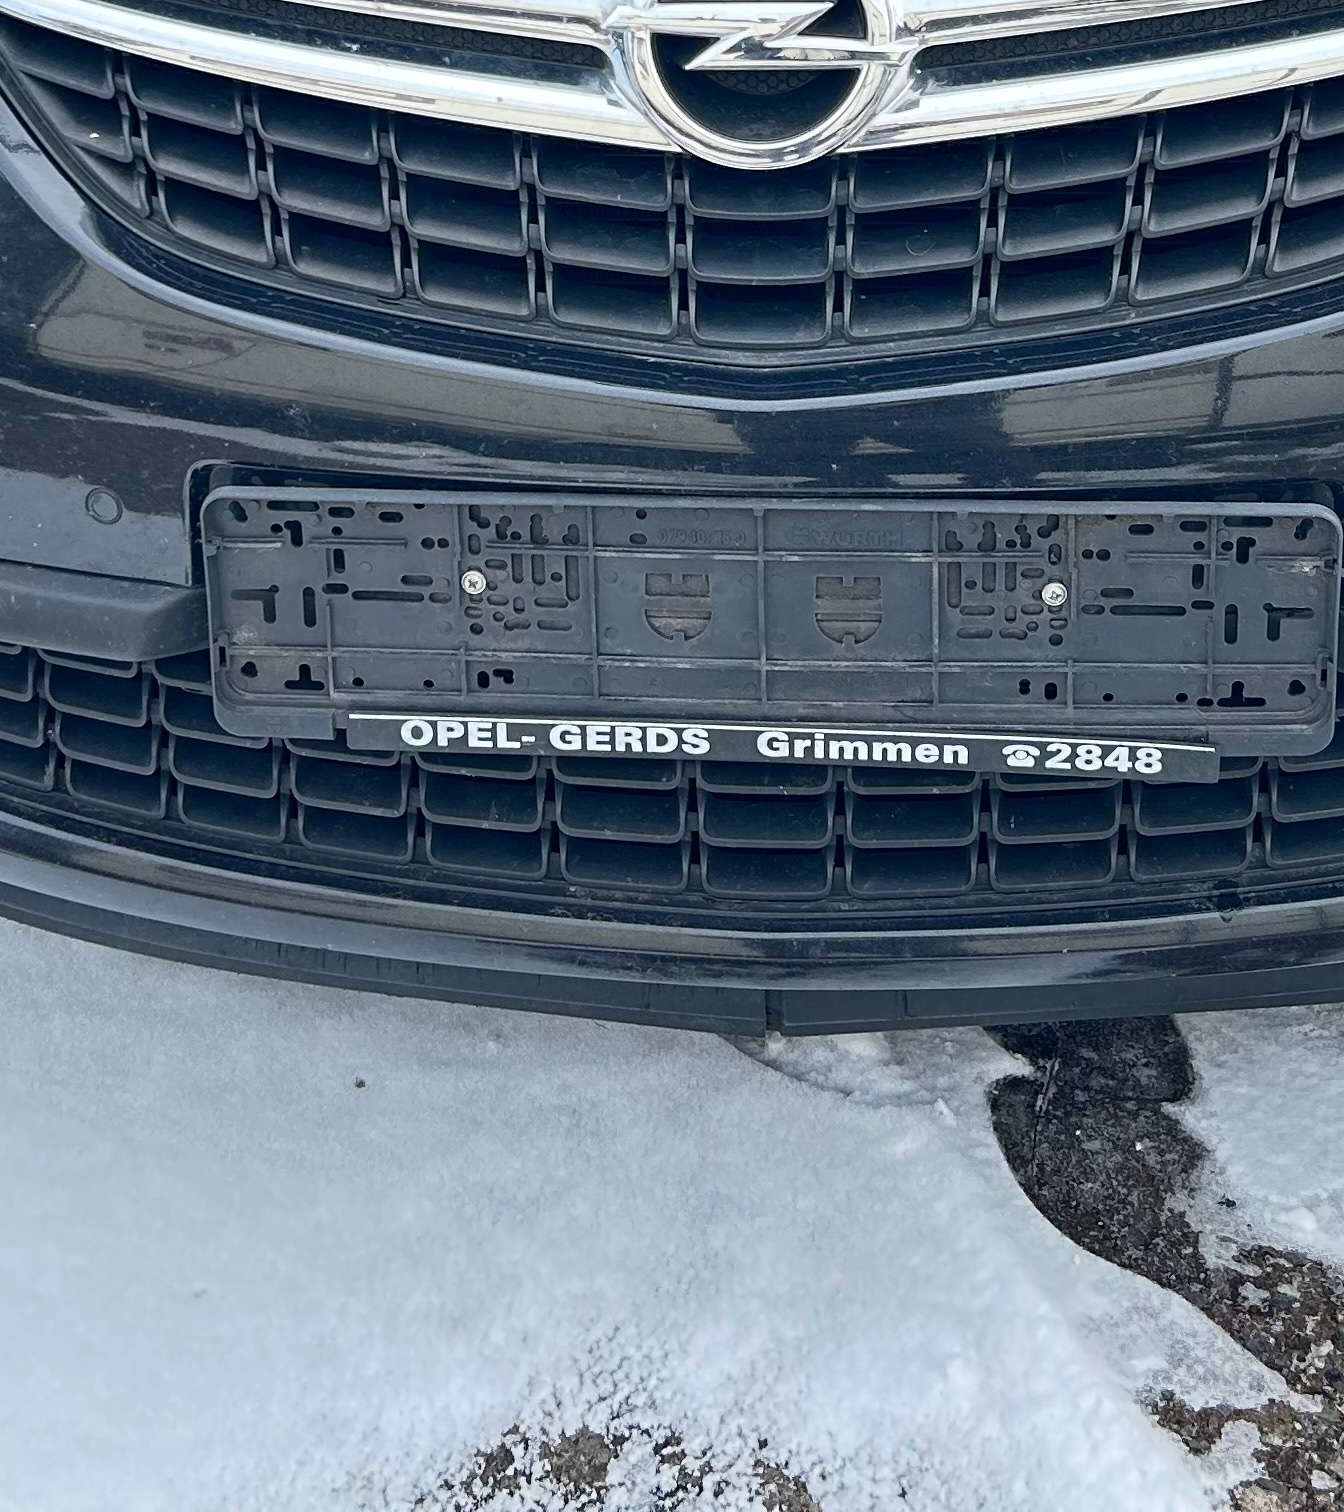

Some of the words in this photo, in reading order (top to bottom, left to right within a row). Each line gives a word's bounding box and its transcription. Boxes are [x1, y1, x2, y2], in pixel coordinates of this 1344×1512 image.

[549, 724, 711, 755] GERDS
[756, 731, 969, 765] Grimmen
[1044, 743, 1164, 774] 2848
